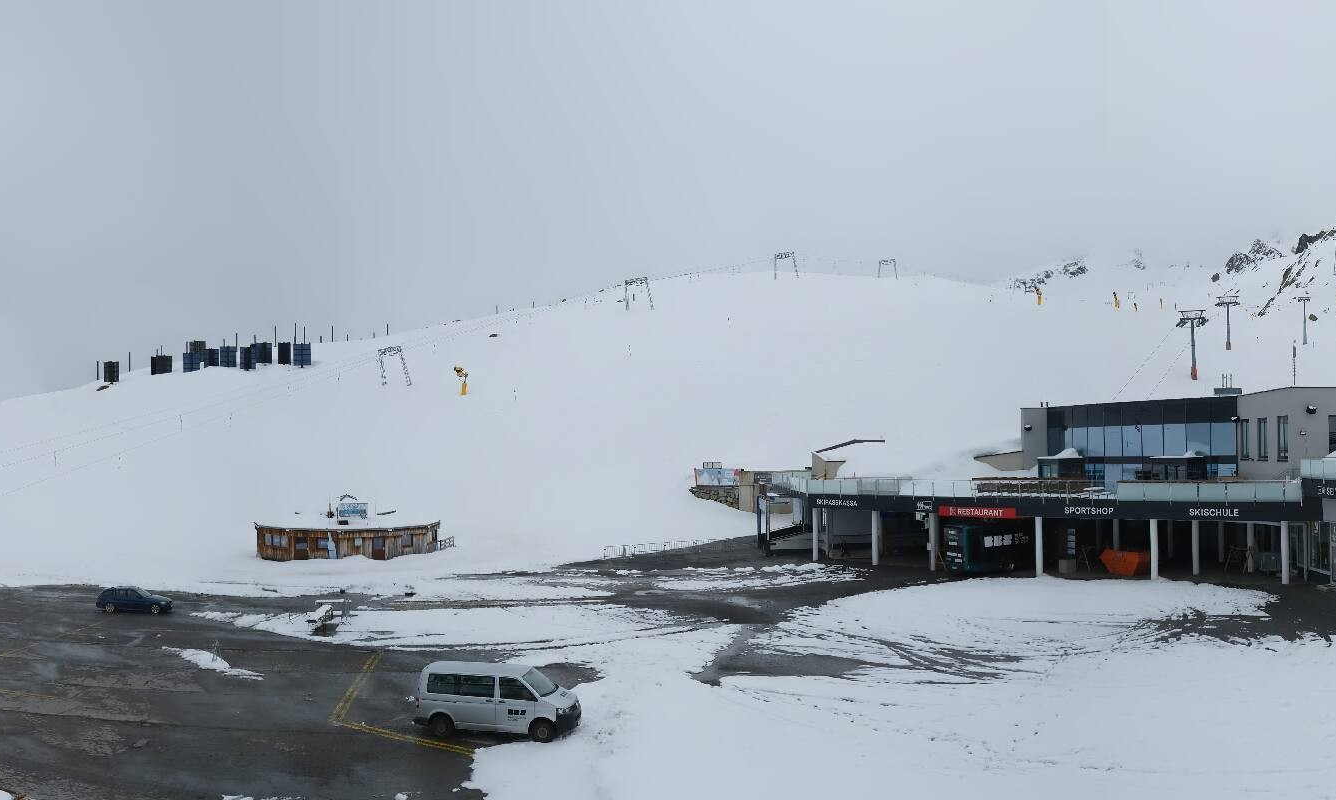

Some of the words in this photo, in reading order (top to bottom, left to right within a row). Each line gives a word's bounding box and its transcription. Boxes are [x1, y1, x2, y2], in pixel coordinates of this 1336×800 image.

[957, 508, 1003, 517] RESTAURANT
[1064, 506, 1114, 515] SPORTSHOP
[1189, 508, 1239, 517] SKISCHULE
